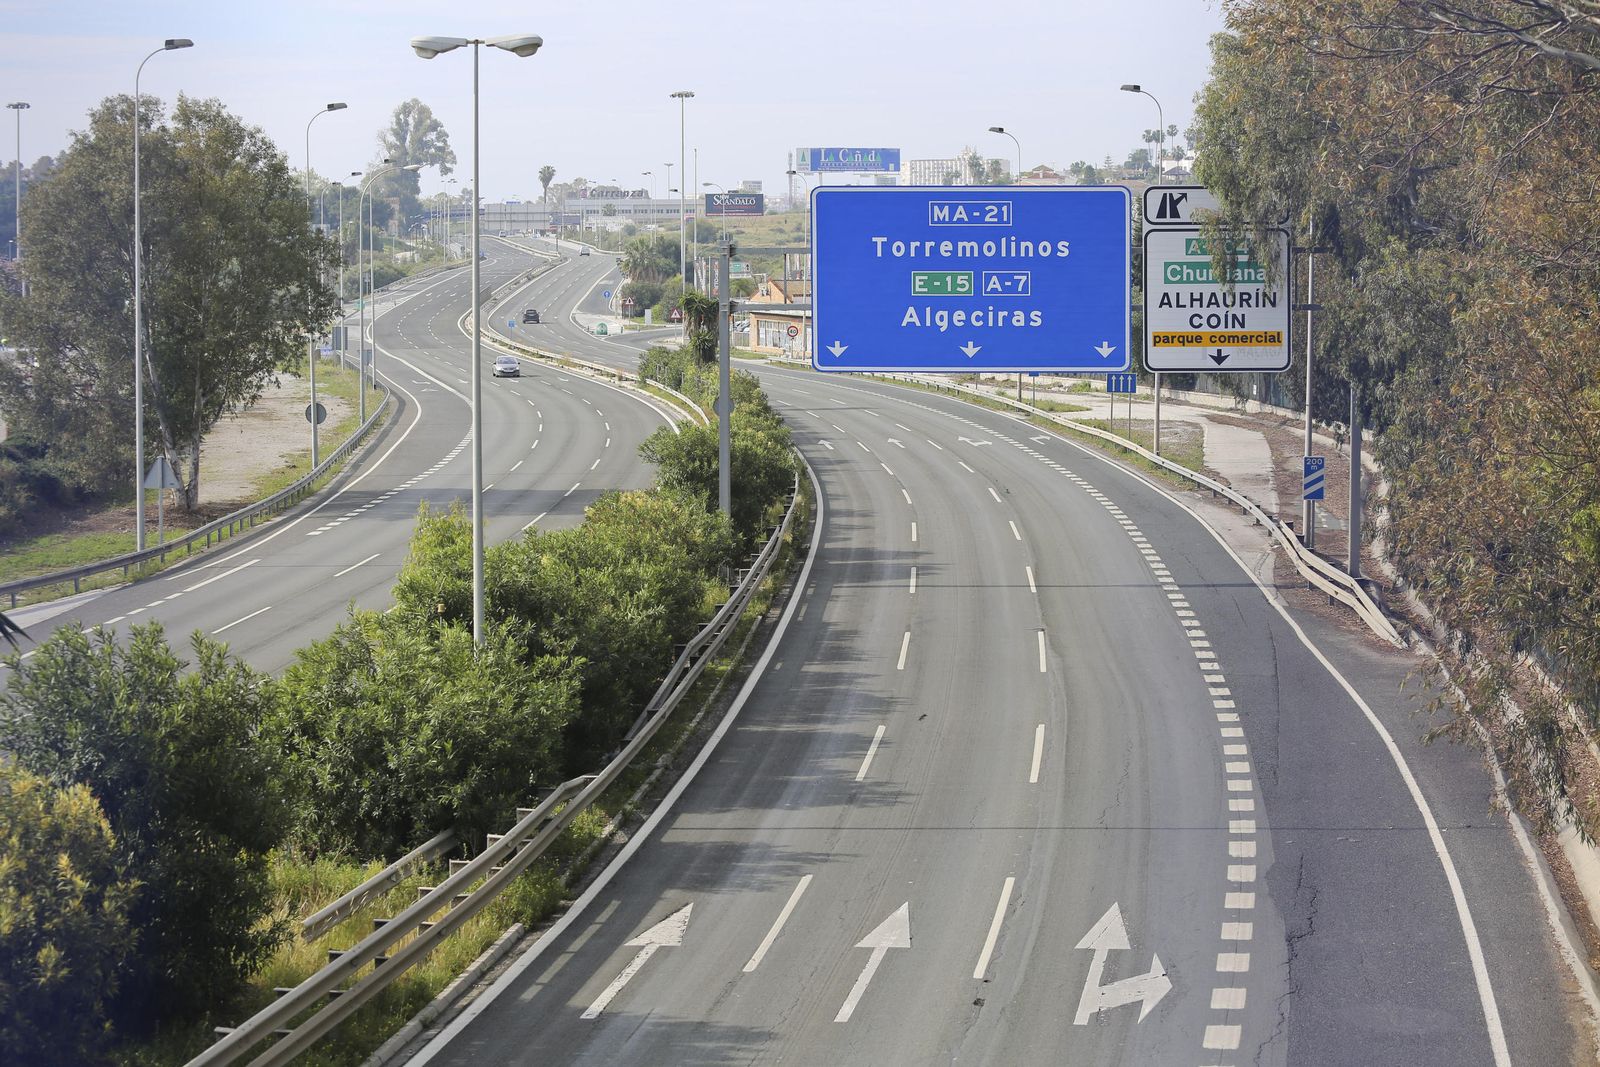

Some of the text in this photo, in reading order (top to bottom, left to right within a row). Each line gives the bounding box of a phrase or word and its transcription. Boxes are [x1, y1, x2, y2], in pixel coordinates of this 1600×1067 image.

[590, 189, 643, 198] Carranza
[933, 205, 1008, 222] MA-21
[872, 236, 1070, 257] Torremolinos
[1166, 265, 1267, 281] Churiana
[915, 275, 1028, 292] E-15 A-7
[1159, 289, 1277, 308] ALHAURÍN
[901, 306, 1042, 332] Algeciras
[1189, 311, 1246, 328] COÍN
[1153, 332, 1282, 346] parque comercial
